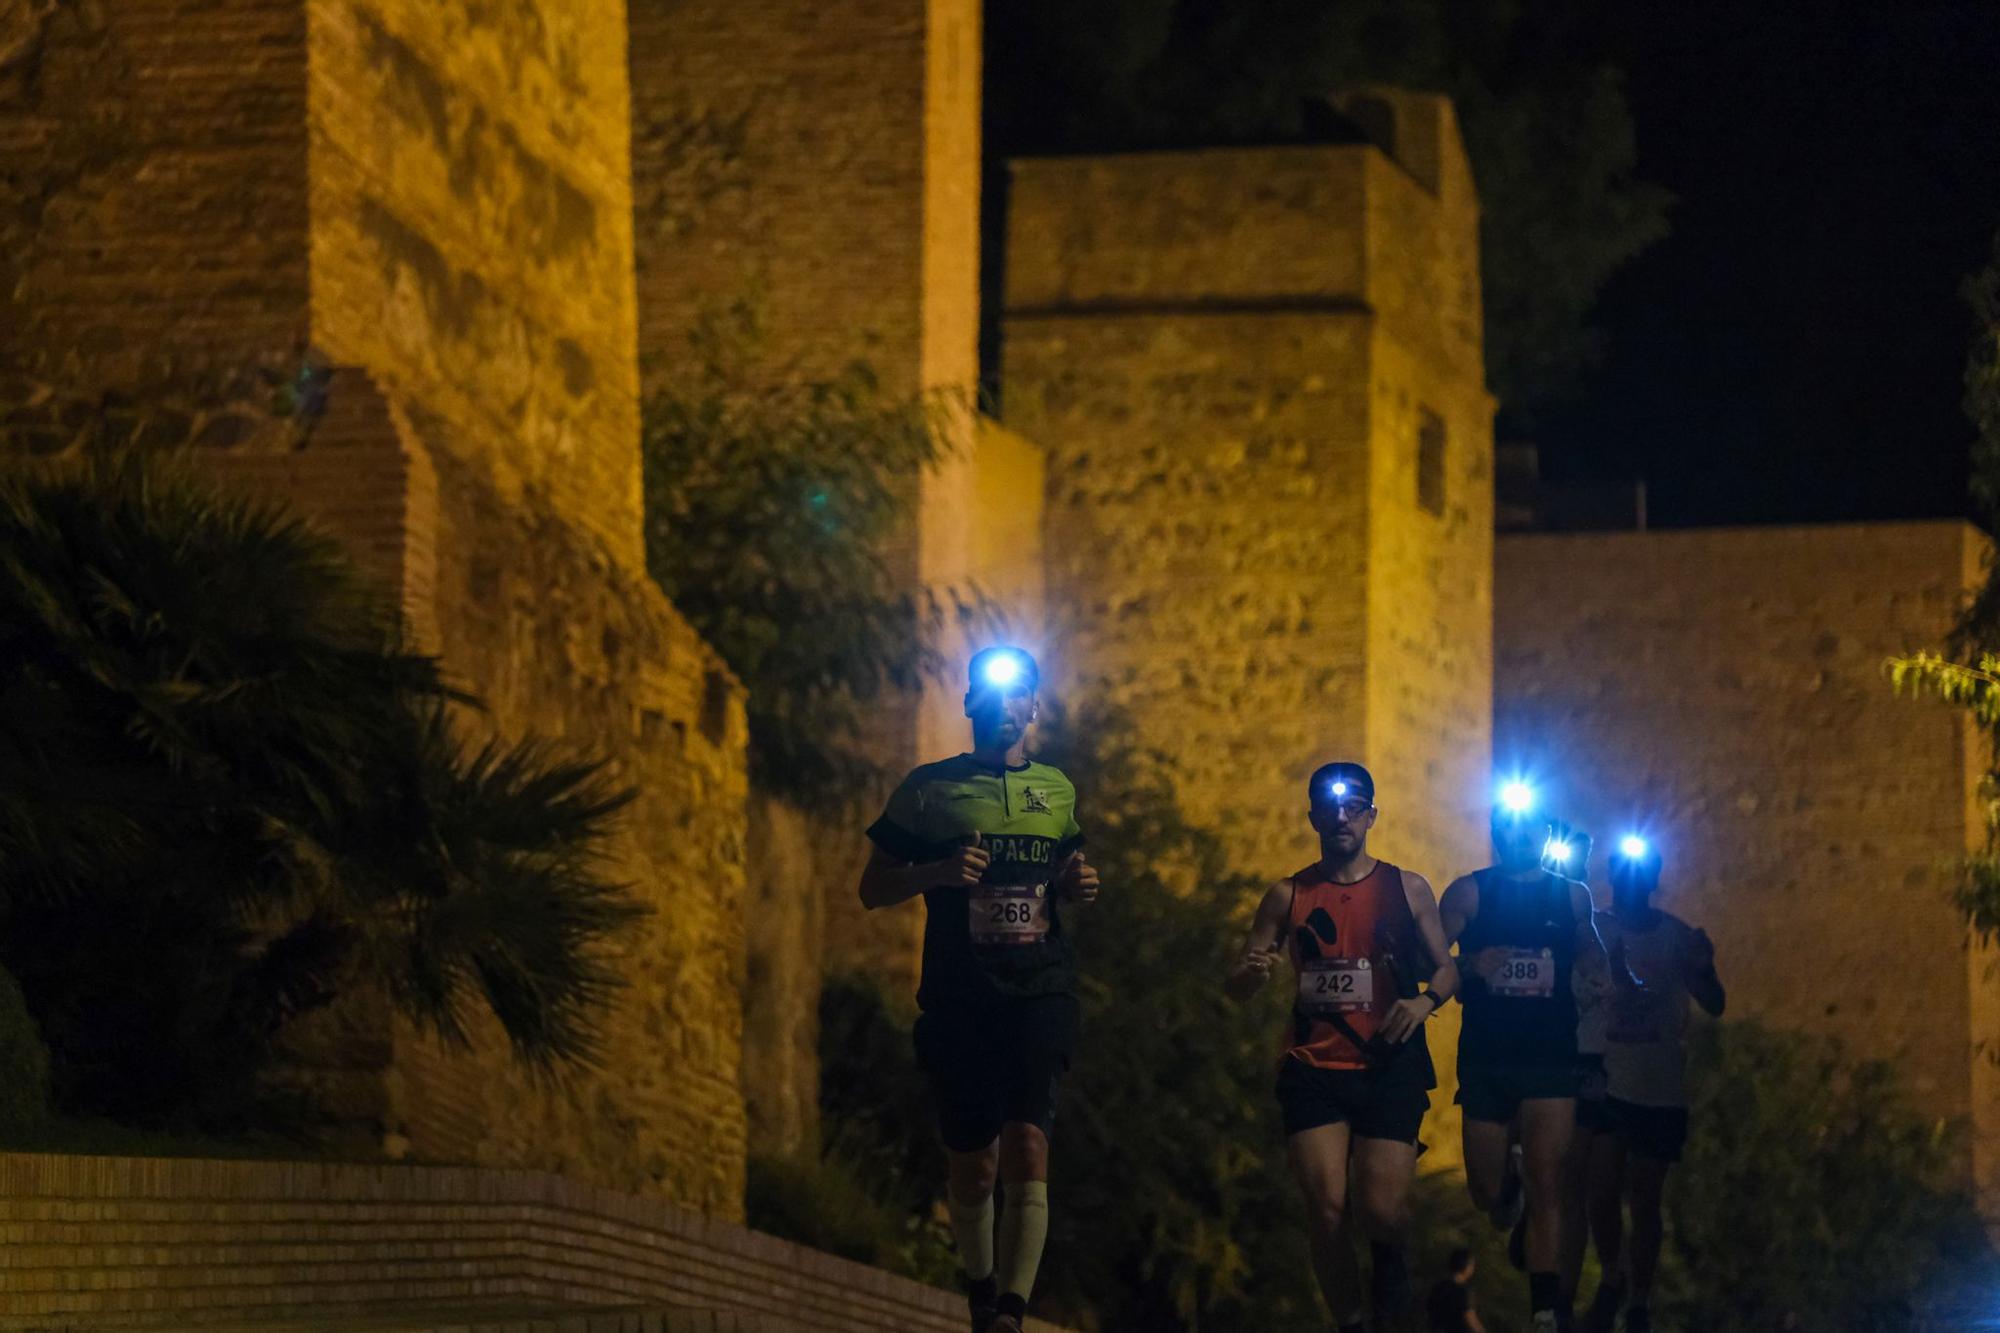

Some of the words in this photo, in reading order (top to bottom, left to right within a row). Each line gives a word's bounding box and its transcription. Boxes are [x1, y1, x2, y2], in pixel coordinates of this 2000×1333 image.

[991, 903, 1031, 923] 268
[1502, 962, 1538, 979] 388
[1316, 974, 1354, 993] 242
